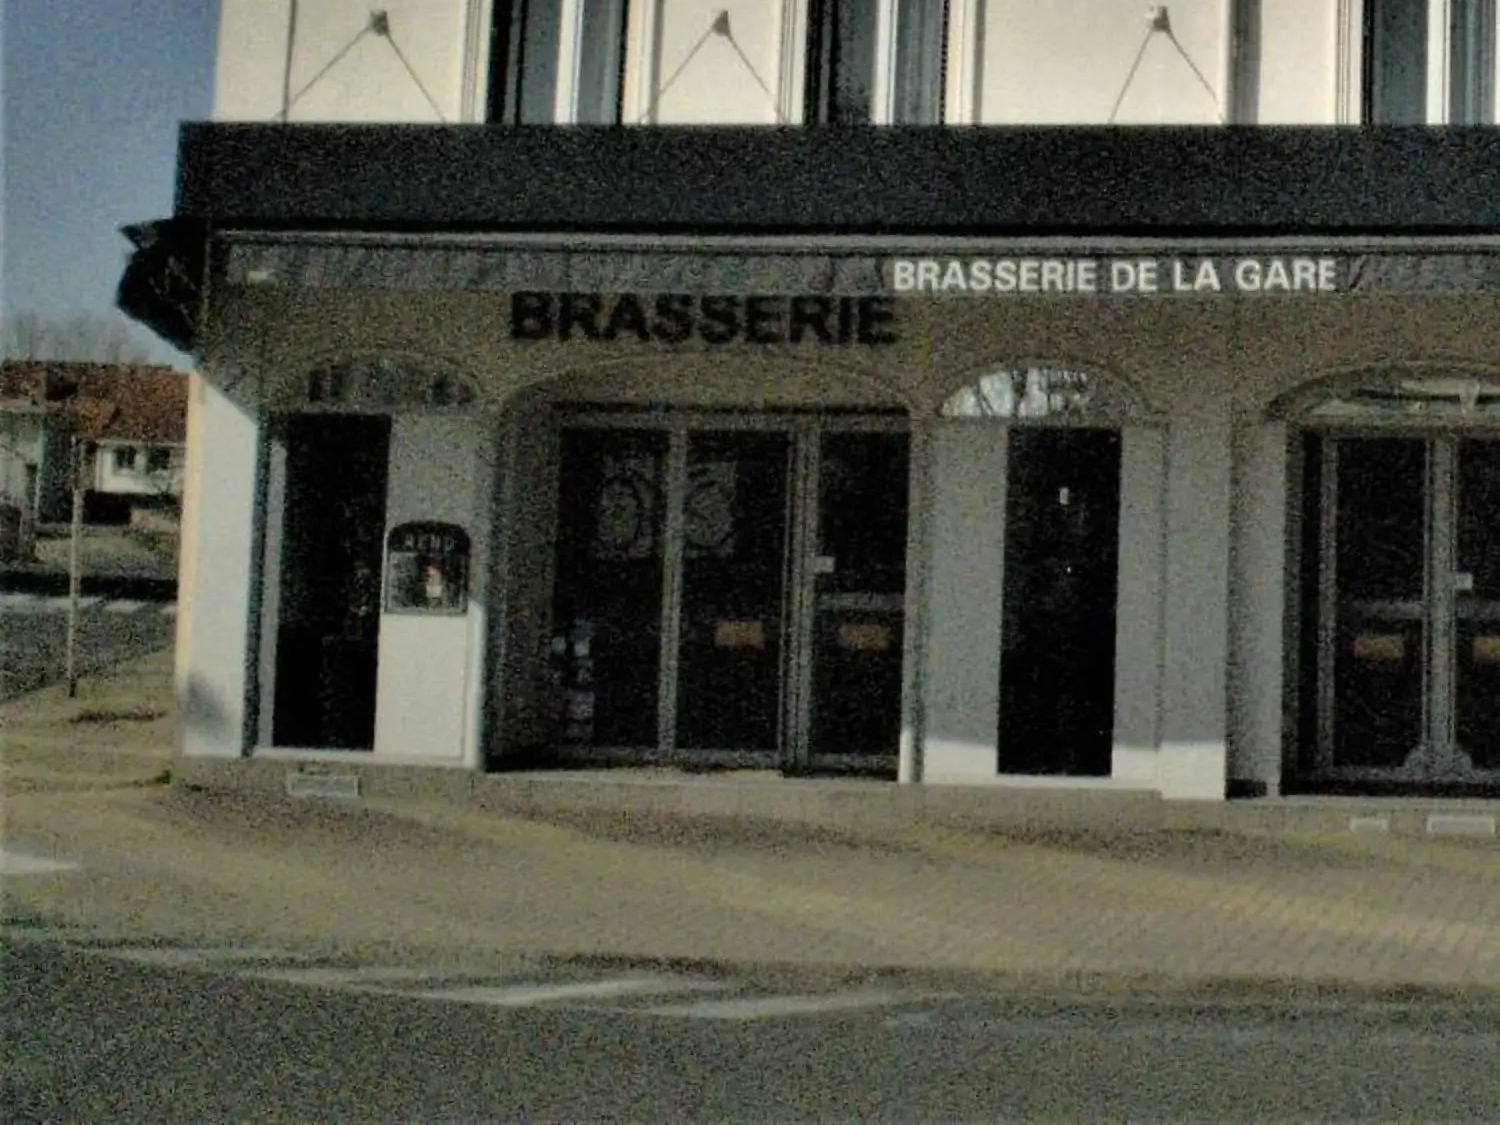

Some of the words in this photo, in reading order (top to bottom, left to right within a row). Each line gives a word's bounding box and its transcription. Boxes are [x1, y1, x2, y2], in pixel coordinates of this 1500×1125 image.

[893, 259, 1096, 292] BRASSERIE
[1110, 260, 1159, 291] DE
[1174, 260, 1220, 290] LA
[1235, 259, 1336, 290] GARE
[511, 291, 898, 345] BRASSERIE
